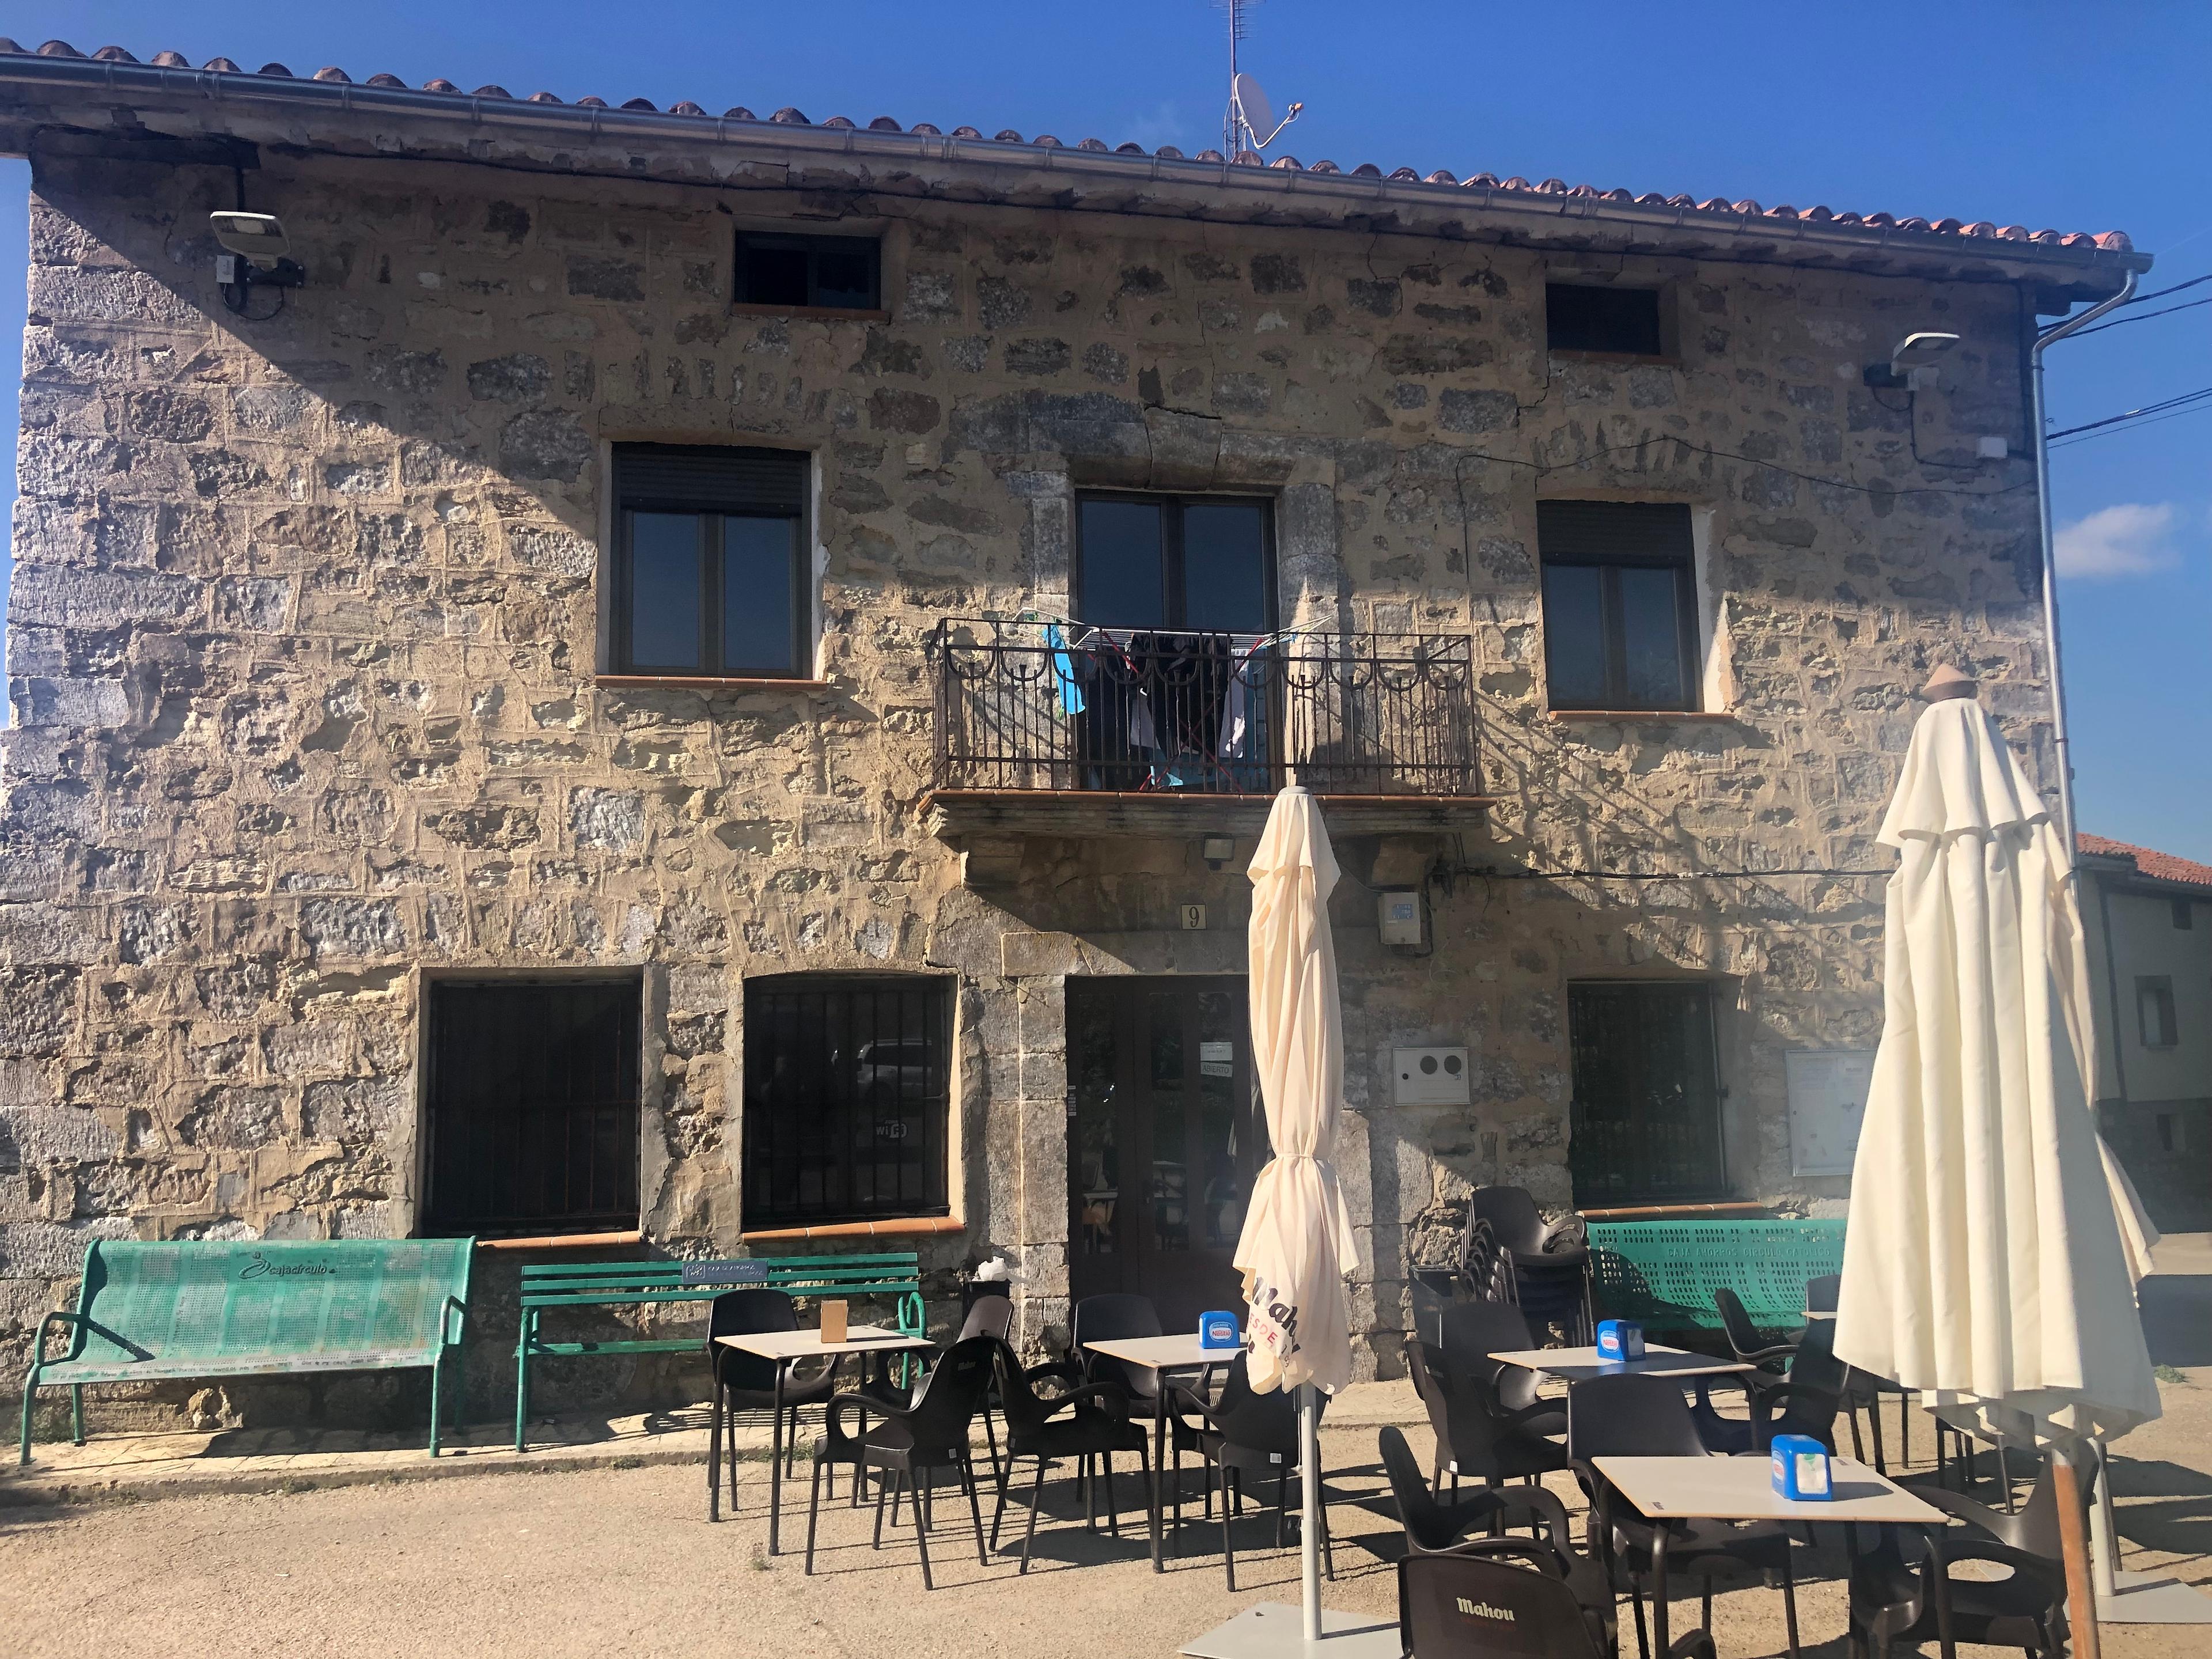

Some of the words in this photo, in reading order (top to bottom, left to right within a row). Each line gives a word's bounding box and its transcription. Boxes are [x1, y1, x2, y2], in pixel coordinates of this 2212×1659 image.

[1189, 907, 1199, 927] 9
[1202, 1065, 1229, 1074] ABIERTO
[1668, 1248, 1691, 1256] CAJA
[1696, 1248, 1738, 1256] AHORROS
[1456, 1597, 1515, 1622] Mahou
